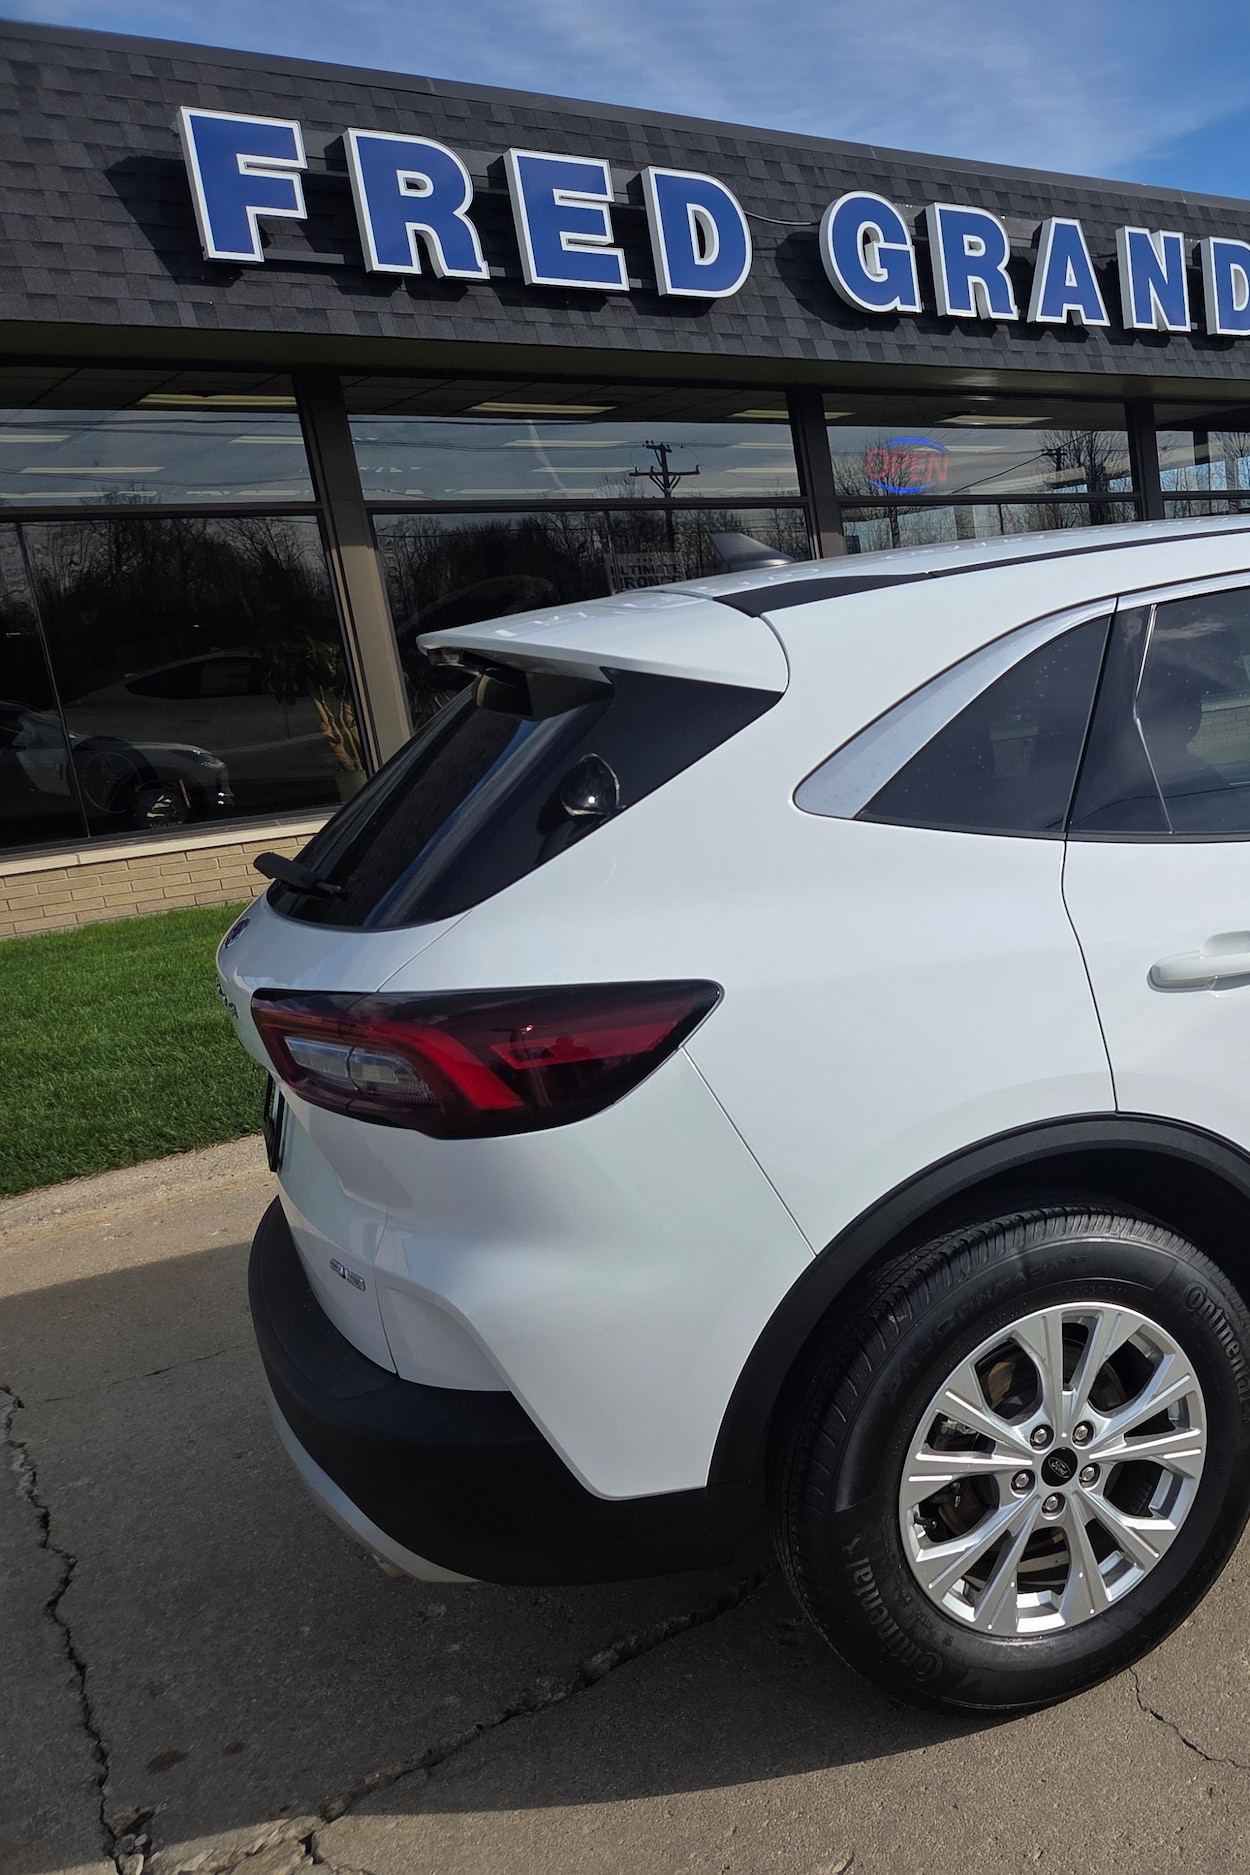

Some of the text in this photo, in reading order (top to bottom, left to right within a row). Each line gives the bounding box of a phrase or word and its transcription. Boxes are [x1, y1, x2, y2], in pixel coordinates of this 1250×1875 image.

[180, 106, 753, 299] FRED
[866, 448, 949, 483] OPEN
[846, 1554, 943, 1682] Continental
